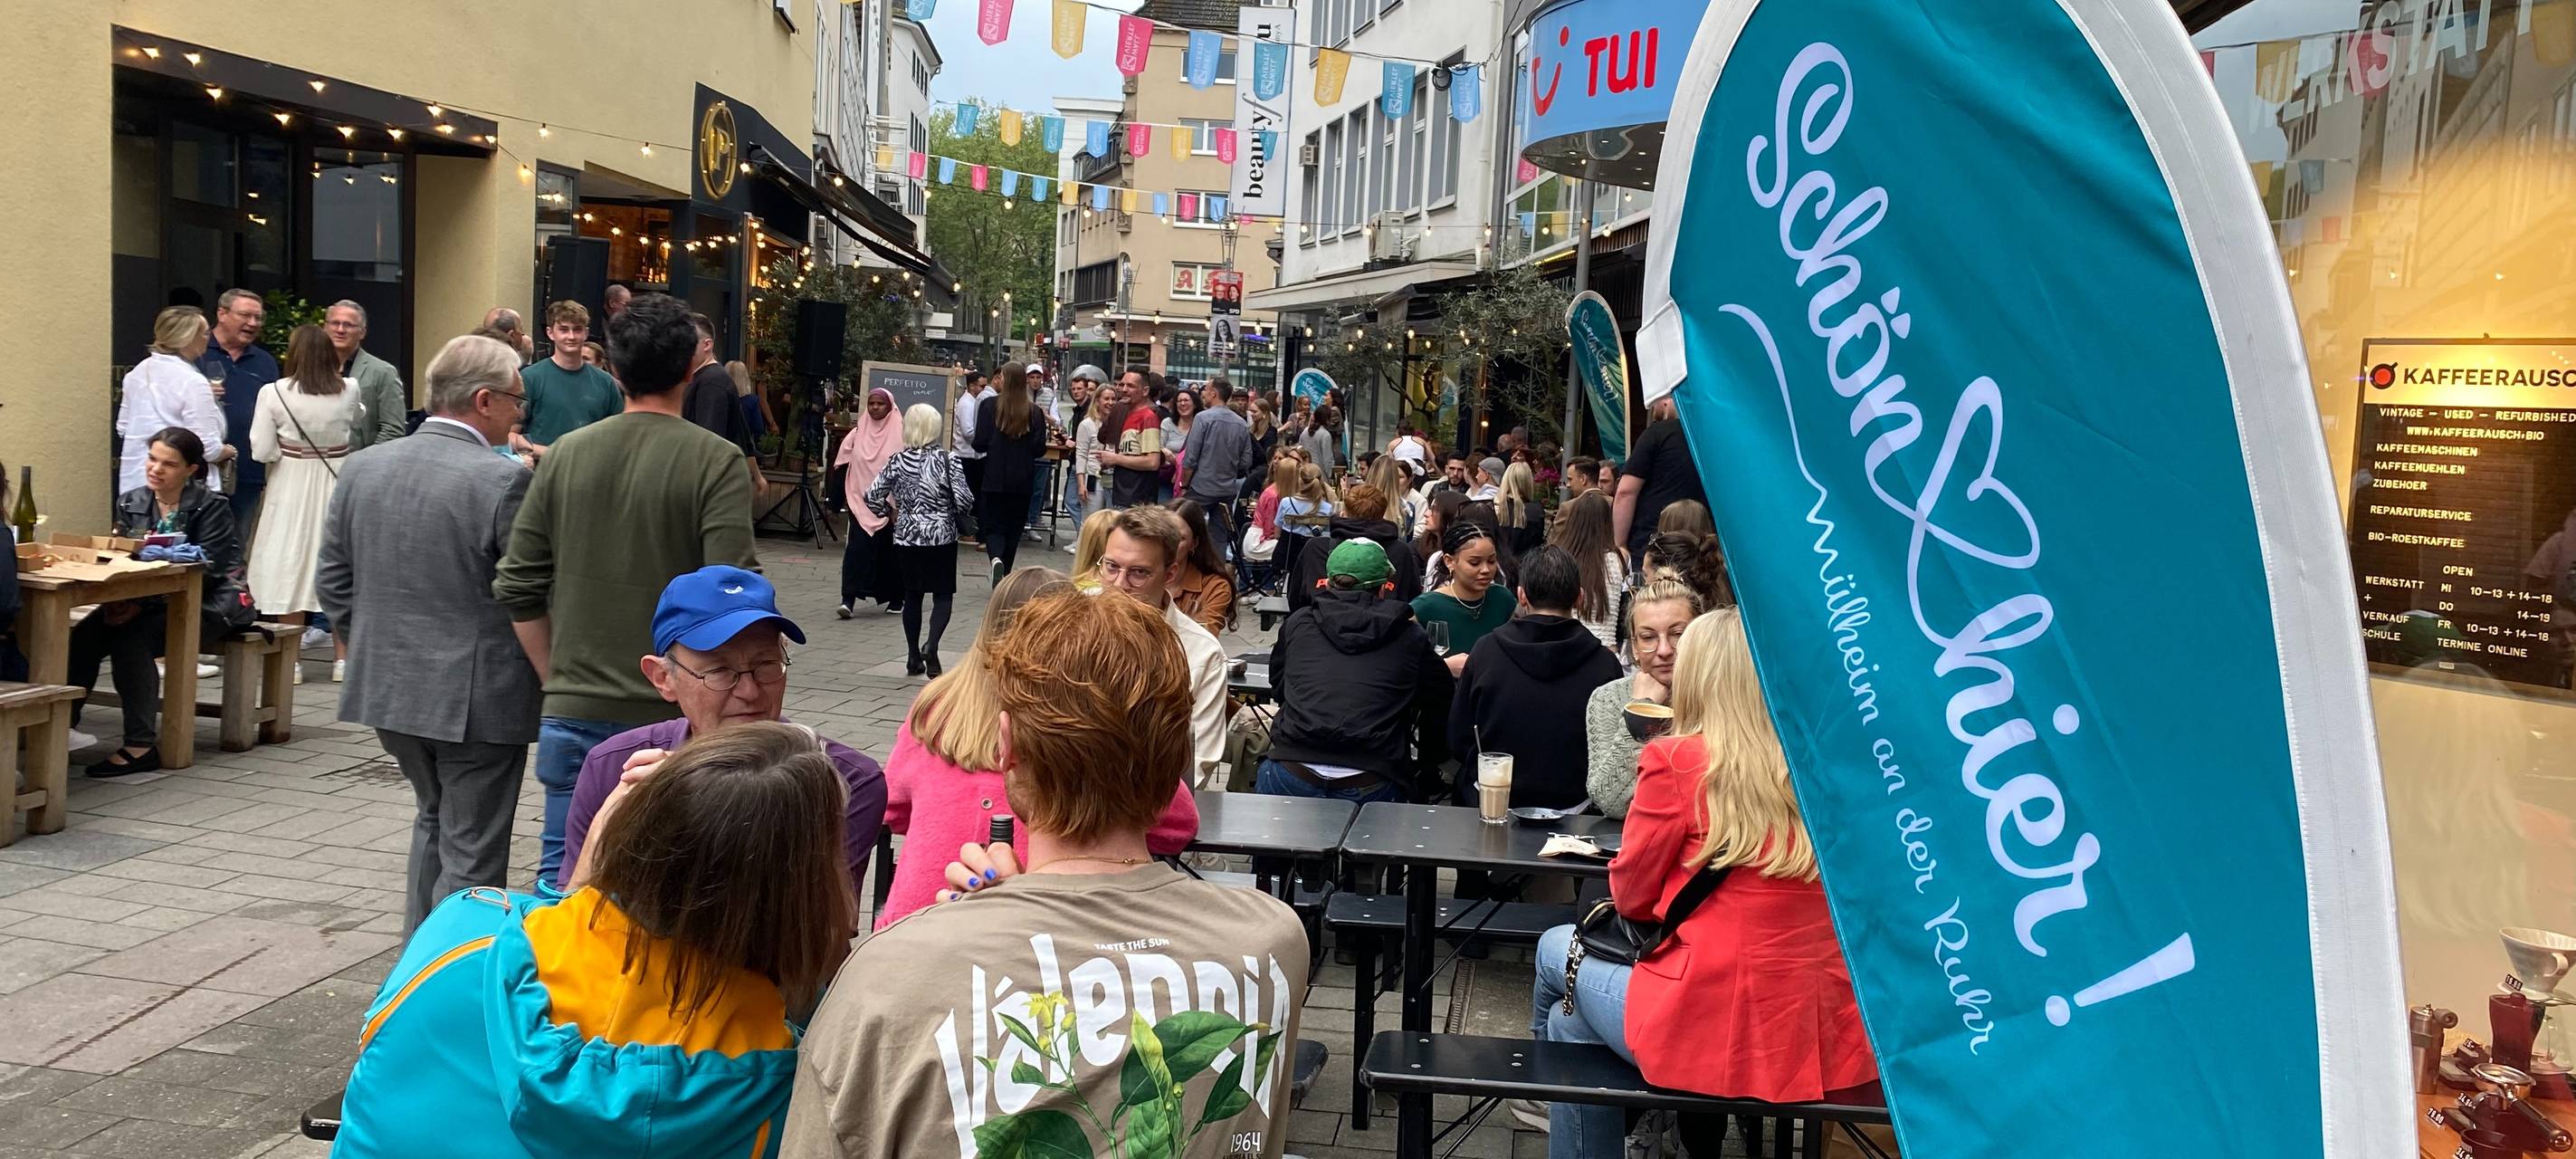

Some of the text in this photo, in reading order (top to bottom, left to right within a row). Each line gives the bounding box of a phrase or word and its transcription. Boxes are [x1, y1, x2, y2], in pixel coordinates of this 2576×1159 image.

[1585, 27, 1659, 98] TUI
[1243, 110, 1272, 198] beauty
[1747, 42, 1922, 471] Schön
[2380, 407, 2424, 418] VINTAGE
[2445, 410, 2474, 419] USED
[2495, 410, 2576, 423] REFURBISHED
[2376, 443, 2478, 457] KAFFEEMASCHINEN
[2374, 461, 2466, 475] KAFFEEMUEHLEN
[2372, 479, 2428, 491] ZUBEHOER
[2370, 504, 2472, 522] REPARATURSERVICE
[2368, 532, 2465, 548] BIO-ROESTKAFFEE
[2442, 565, 2474, 578] OPEN
[2365, 575, 2425, 589] WERKSTATT
[2441, 583, 2452, 592] MI
[2438, 601, 2454, 611] DO
[2362, 610, 2410, 624] VERKAUF
[2437, 619, 2451, 629] FR
[2361, 627, 2401, 641] SCHULE
[2437, 637, 2528, 658] TERMINE ONLINE
[1873, 738, 1905, 795] an
[1895, 808, 1936, 894] der
[1924, 896, 1995, 1056] Ruhr
[1093, 937, 1170, 952] TASTE THE SUN
[1230, 1131, 1262, 1154] 1964
